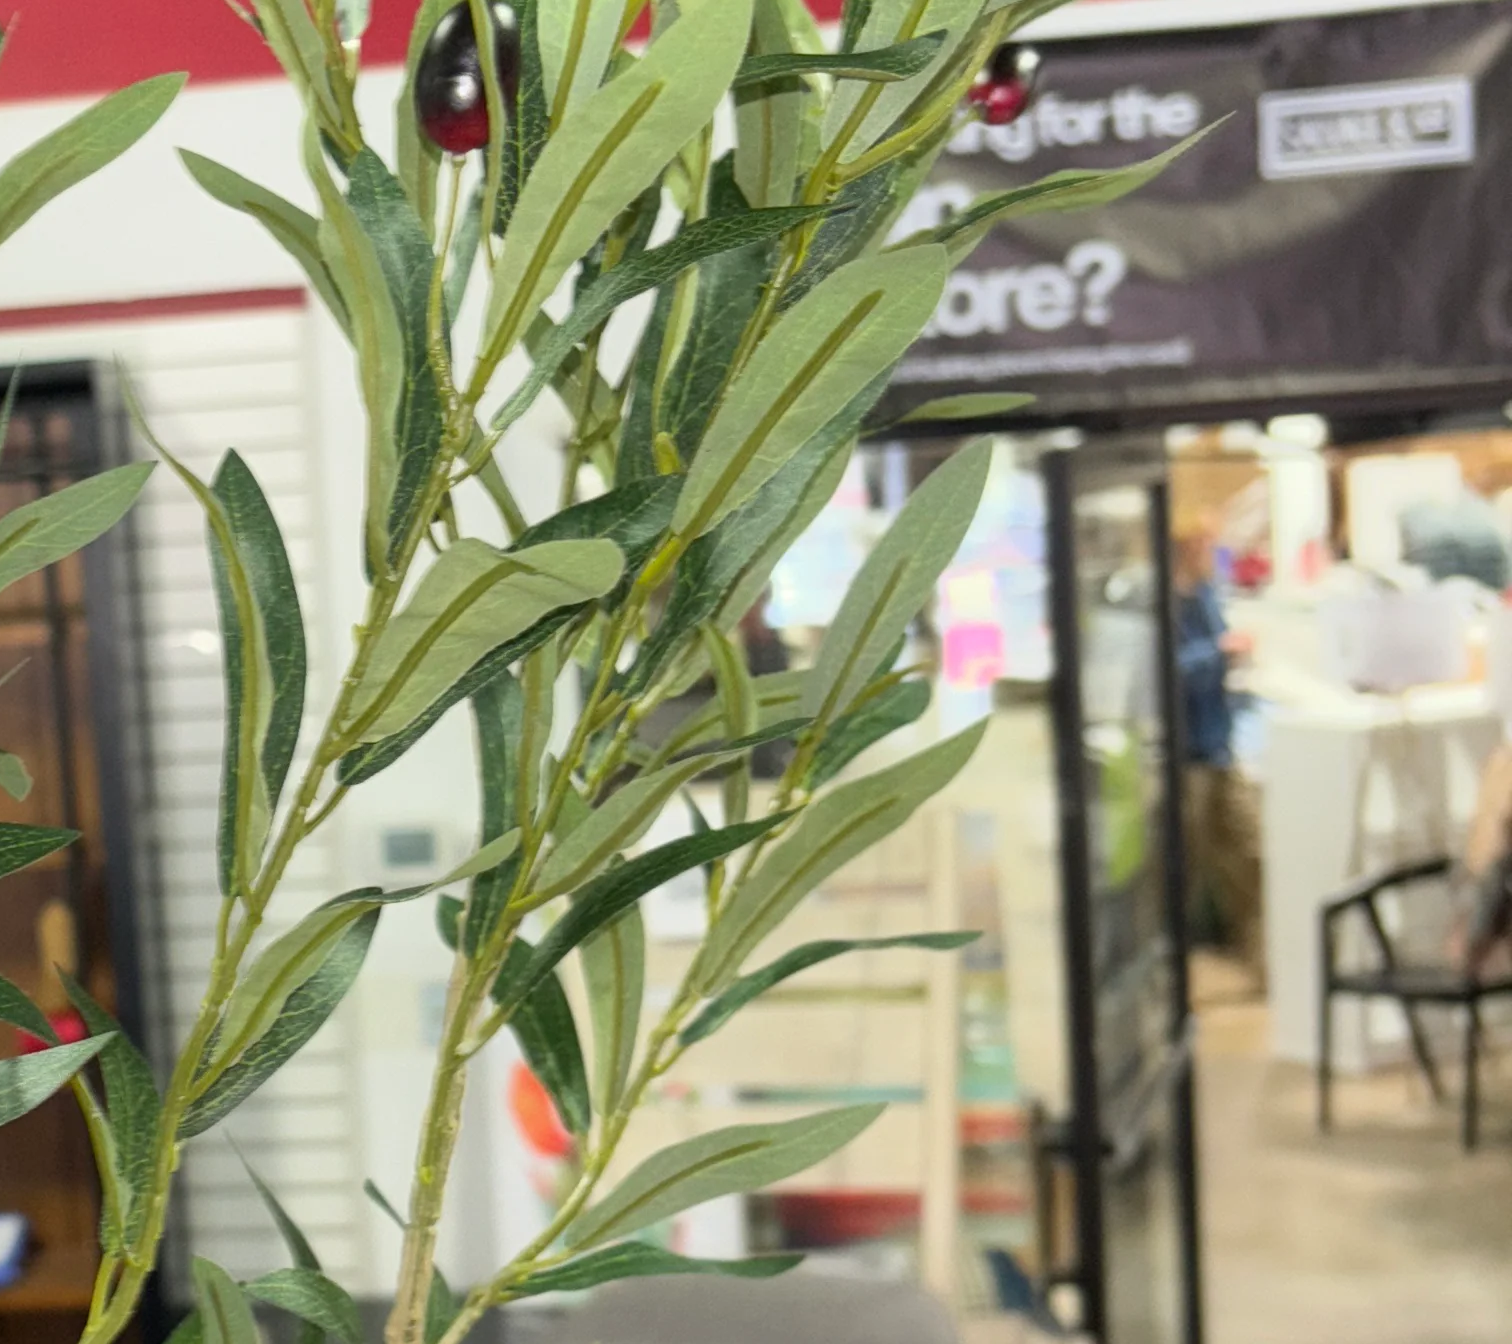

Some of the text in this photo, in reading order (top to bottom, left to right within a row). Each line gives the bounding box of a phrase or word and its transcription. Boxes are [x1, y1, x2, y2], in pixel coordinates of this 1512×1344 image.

[1038, 92, 1108, 147] for
[1110, 86, 1201, 142] the
[922, 240, 1128, 339] ore?
